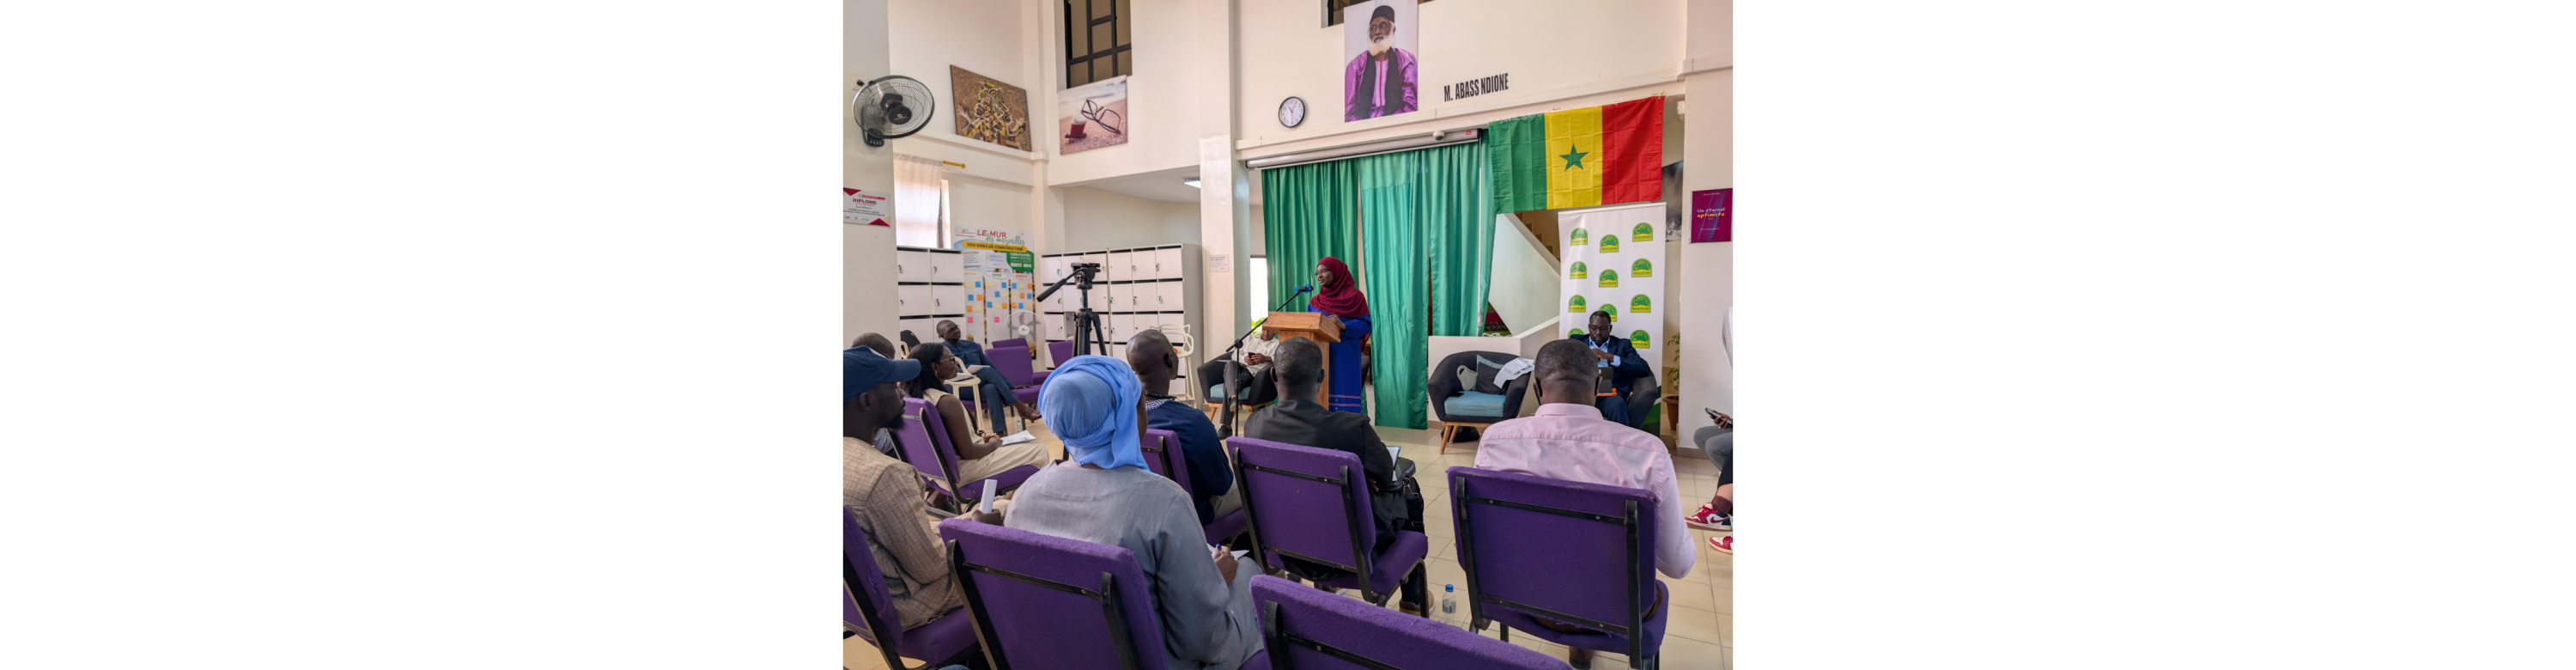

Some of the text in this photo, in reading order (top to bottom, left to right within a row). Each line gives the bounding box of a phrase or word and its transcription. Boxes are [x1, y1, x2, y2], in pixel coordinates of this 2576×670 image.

[1443, 72, 1509, 102] M. ABASS NDIONE
[986, 232, 1025, 248] des merveilles
[989, 230, 1007, 239] MUR
